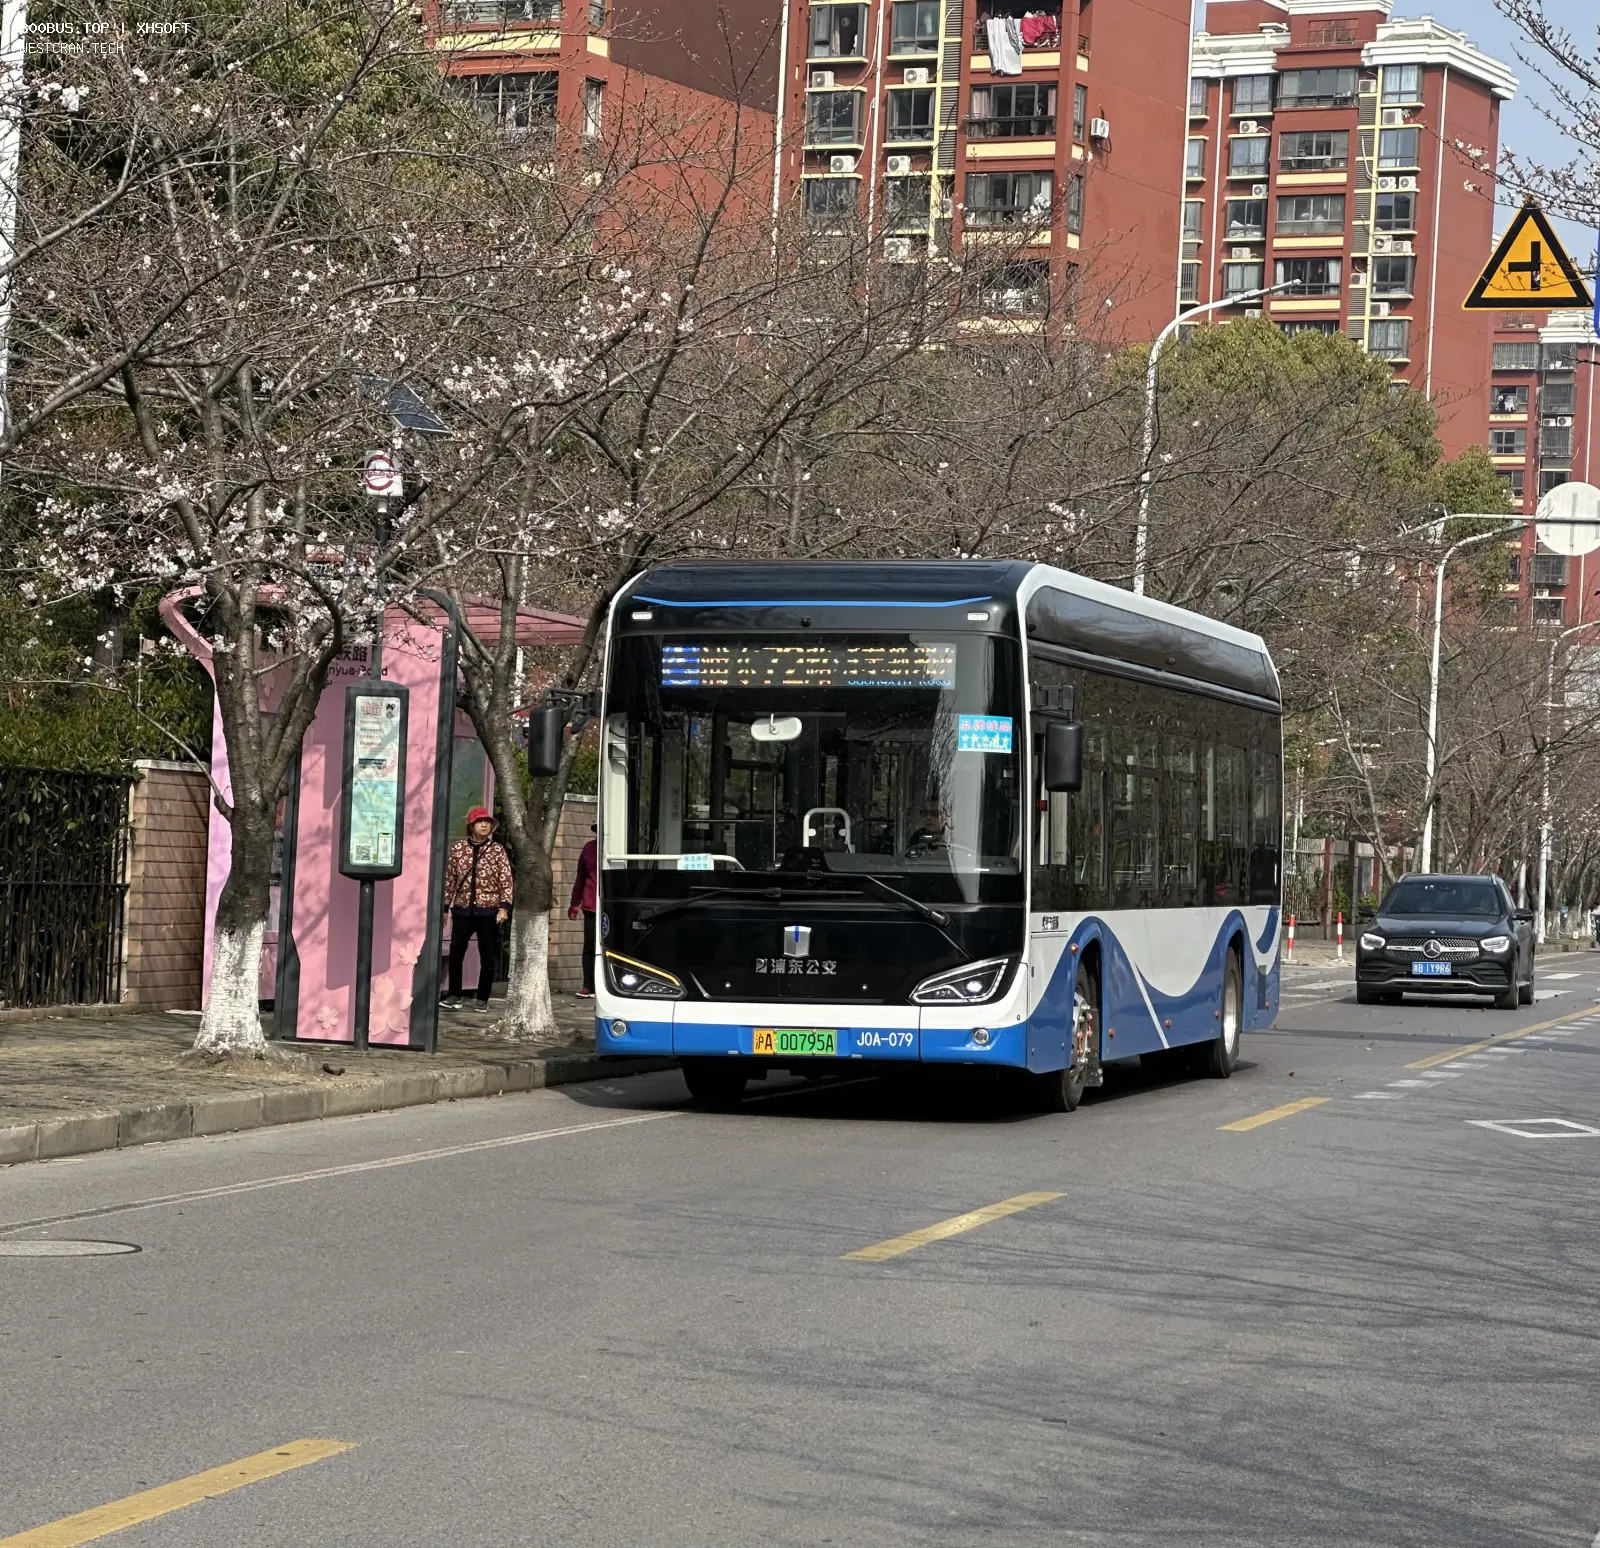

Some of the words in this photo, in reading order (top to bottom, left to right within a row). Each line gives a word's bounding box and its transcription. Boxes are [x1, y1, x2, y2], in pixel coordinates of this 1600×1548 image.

[359, 665, 388, 676] Rod
[771, 959, 837, 975] 浦东公交
